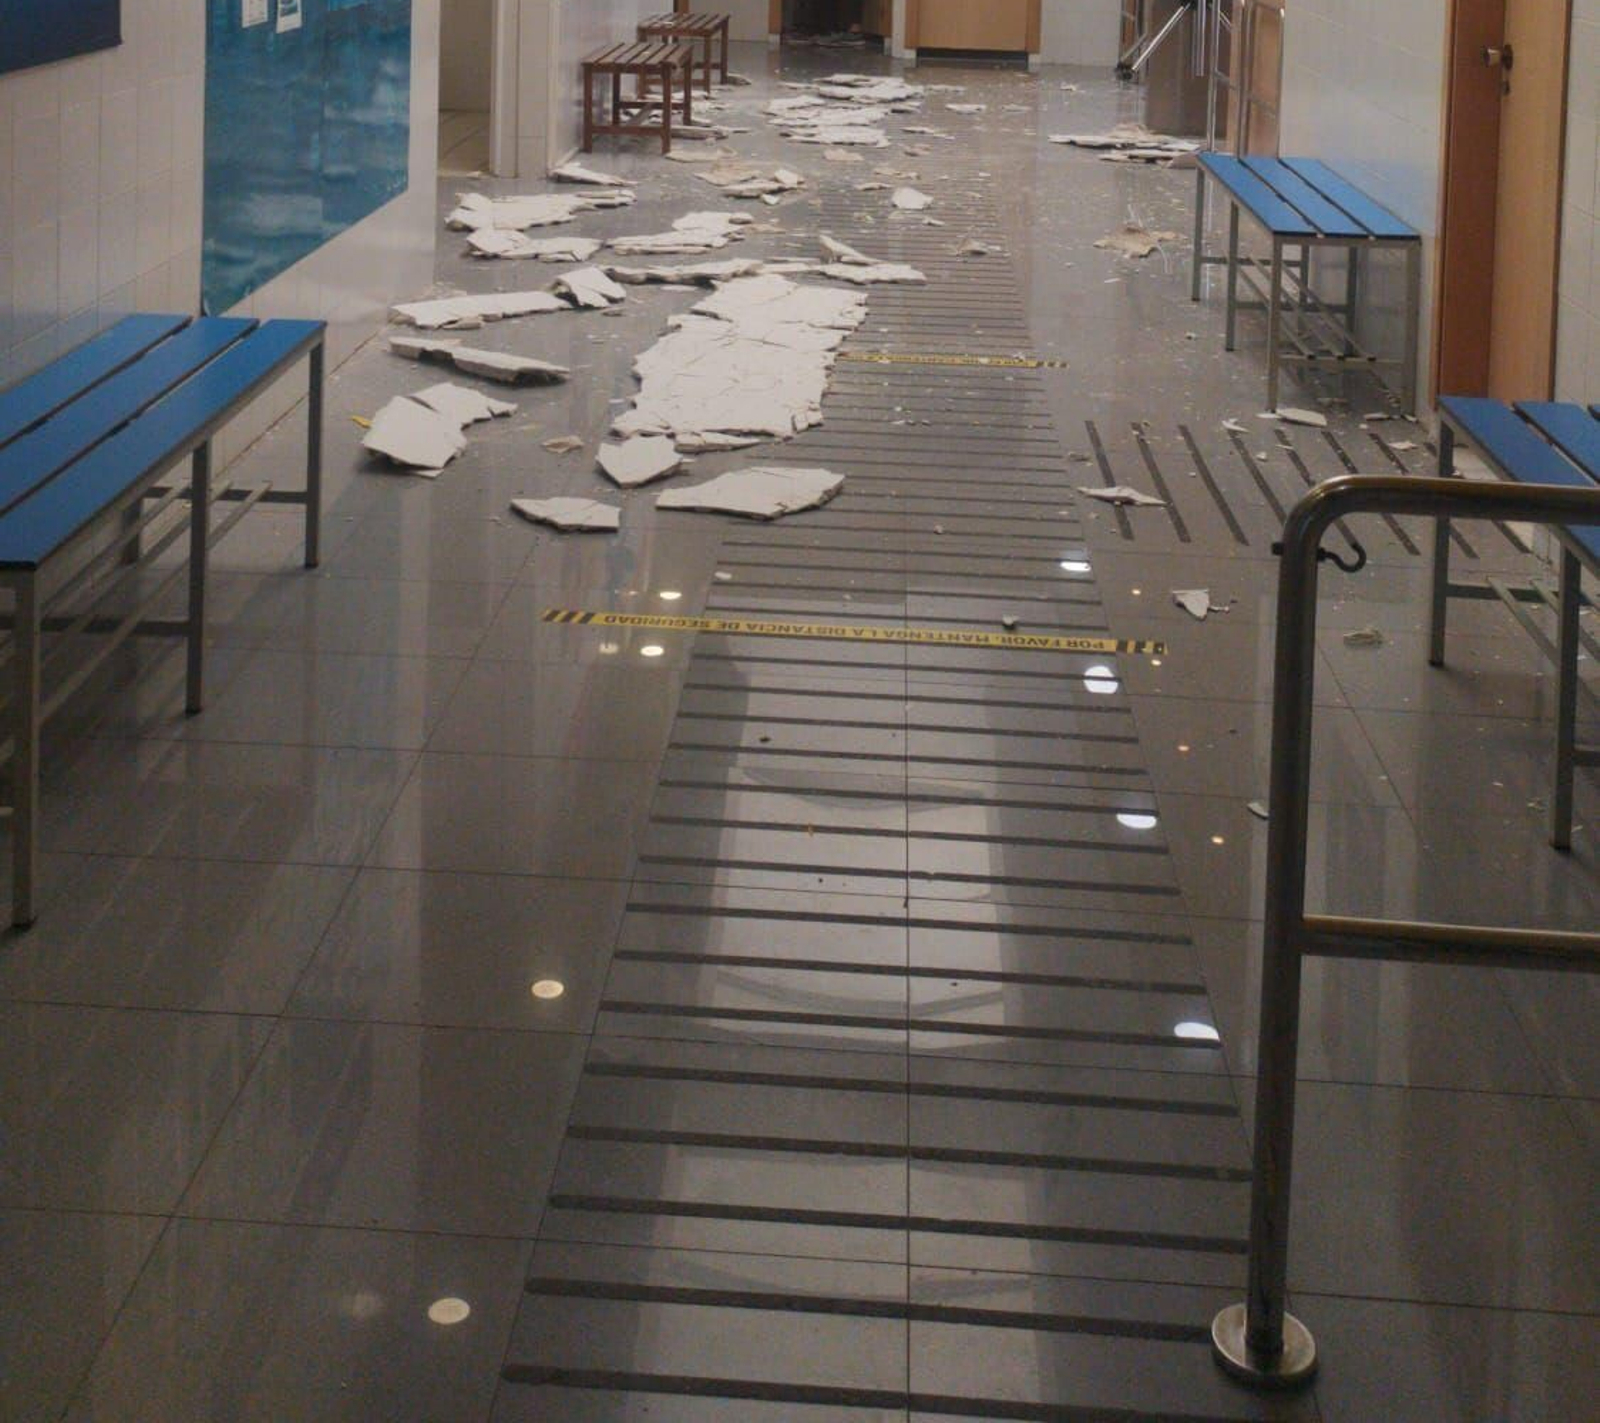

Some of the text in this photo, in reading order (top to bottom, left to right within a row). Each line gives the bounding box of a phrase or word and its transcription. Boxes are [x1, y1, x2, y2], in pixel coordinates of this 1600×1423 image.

[604, 614, 711, 629] SEGURIDAD
[720, 619, 740, 630] DE
[749, 620, 846, 636] DISTANCIA
[853, 627, 878, 638] LA
[884, 629, 990, 644] MANTENGA
[1067, 639, 1105, 650] POR
